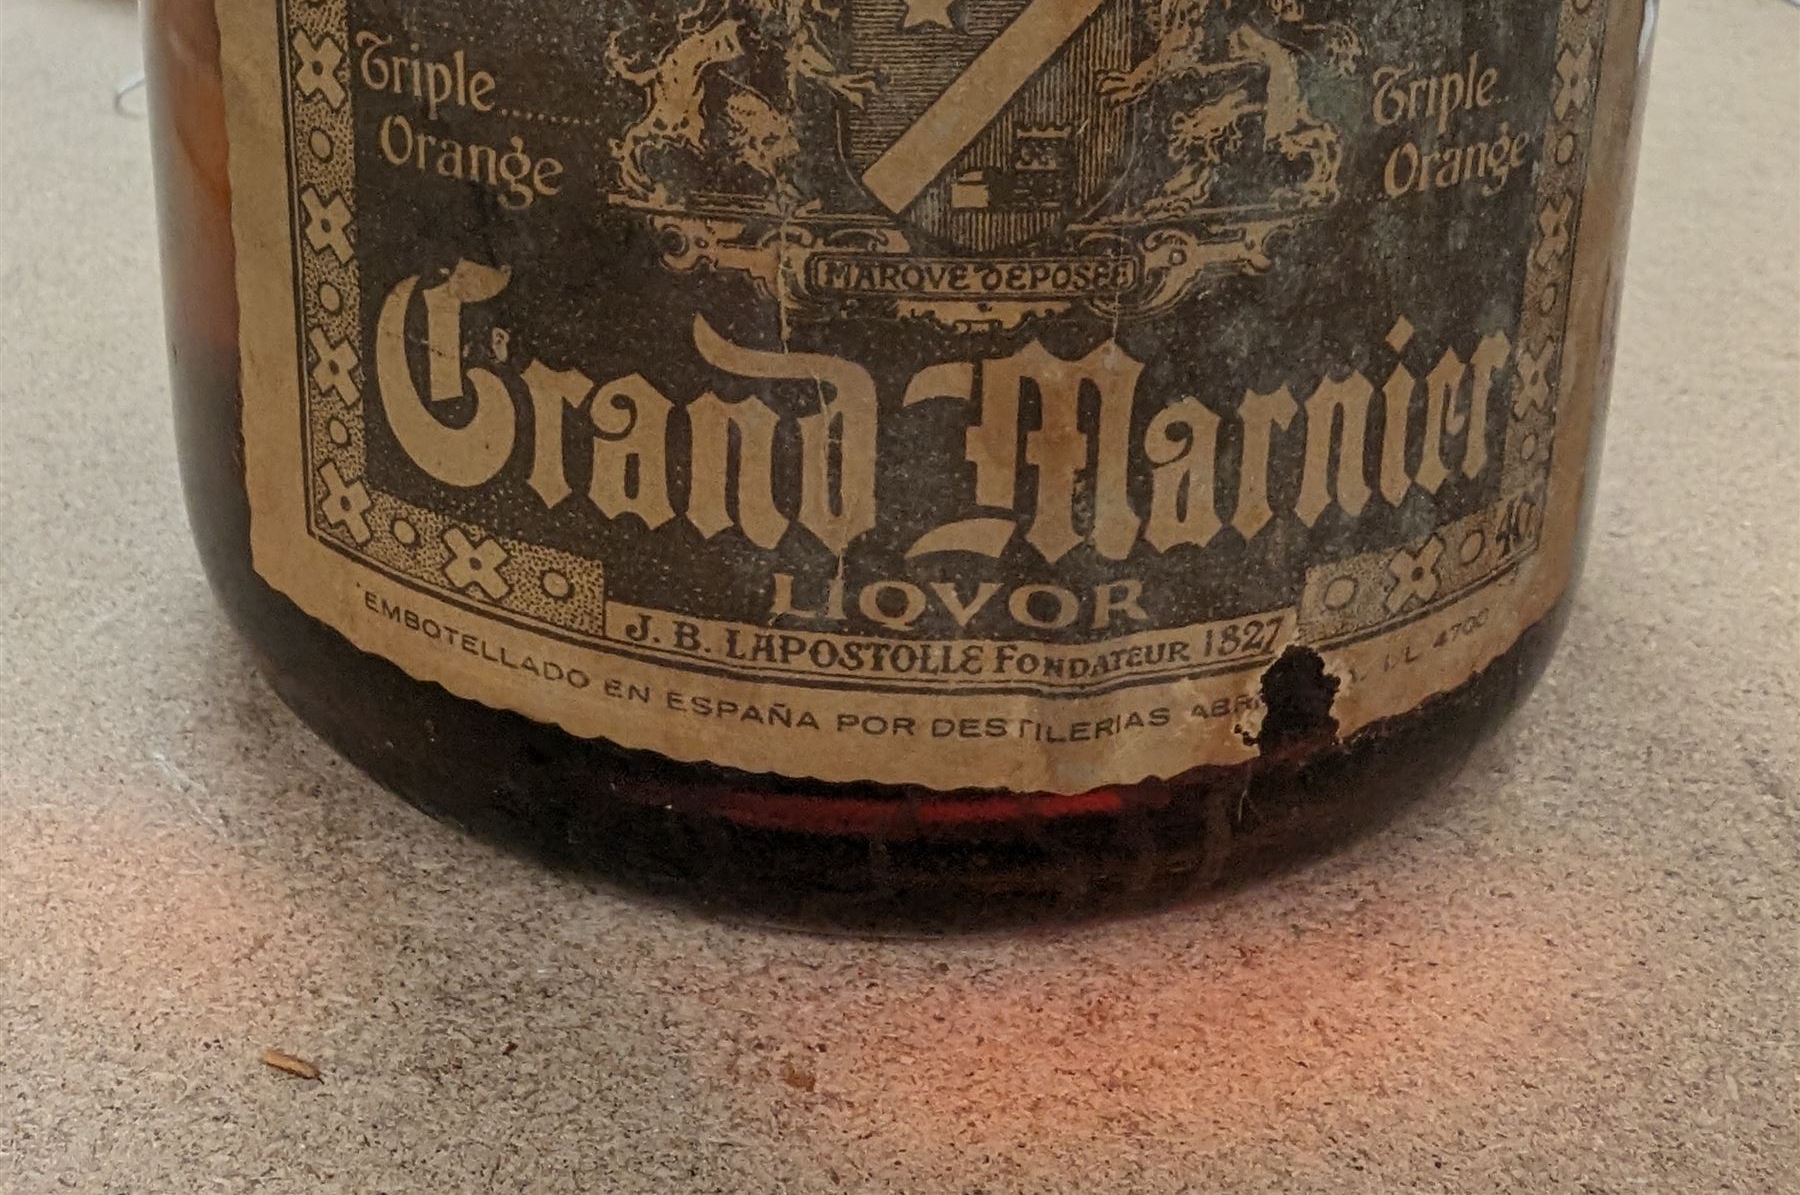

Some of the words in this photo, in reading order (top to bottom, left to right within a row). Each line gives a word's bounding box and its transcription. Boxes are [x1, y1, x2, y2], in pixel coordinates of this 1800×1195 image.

[356, 31, 495, 119] Triple
[1372, 51, 1498, 133] Triple
[380, 115, 564, 211] Orange
[1384, 121, 1530, 198] Orange
[376, 257, 877, 554] Grand
[902, 315, 1511, 564] Marnier
[364, 590, 591, 689] EMBOTELLADO
[604, 679, 650, 703] EN
[667, 691, 820, 731] ESPAÑA
[837, 713, 915, 736] POR
[932, 707, 1170, 743] DESTILERIAS
[725, 628, 984, 676] LAPOSTOLLE
[1204, 615, 1284, 657] 1827
